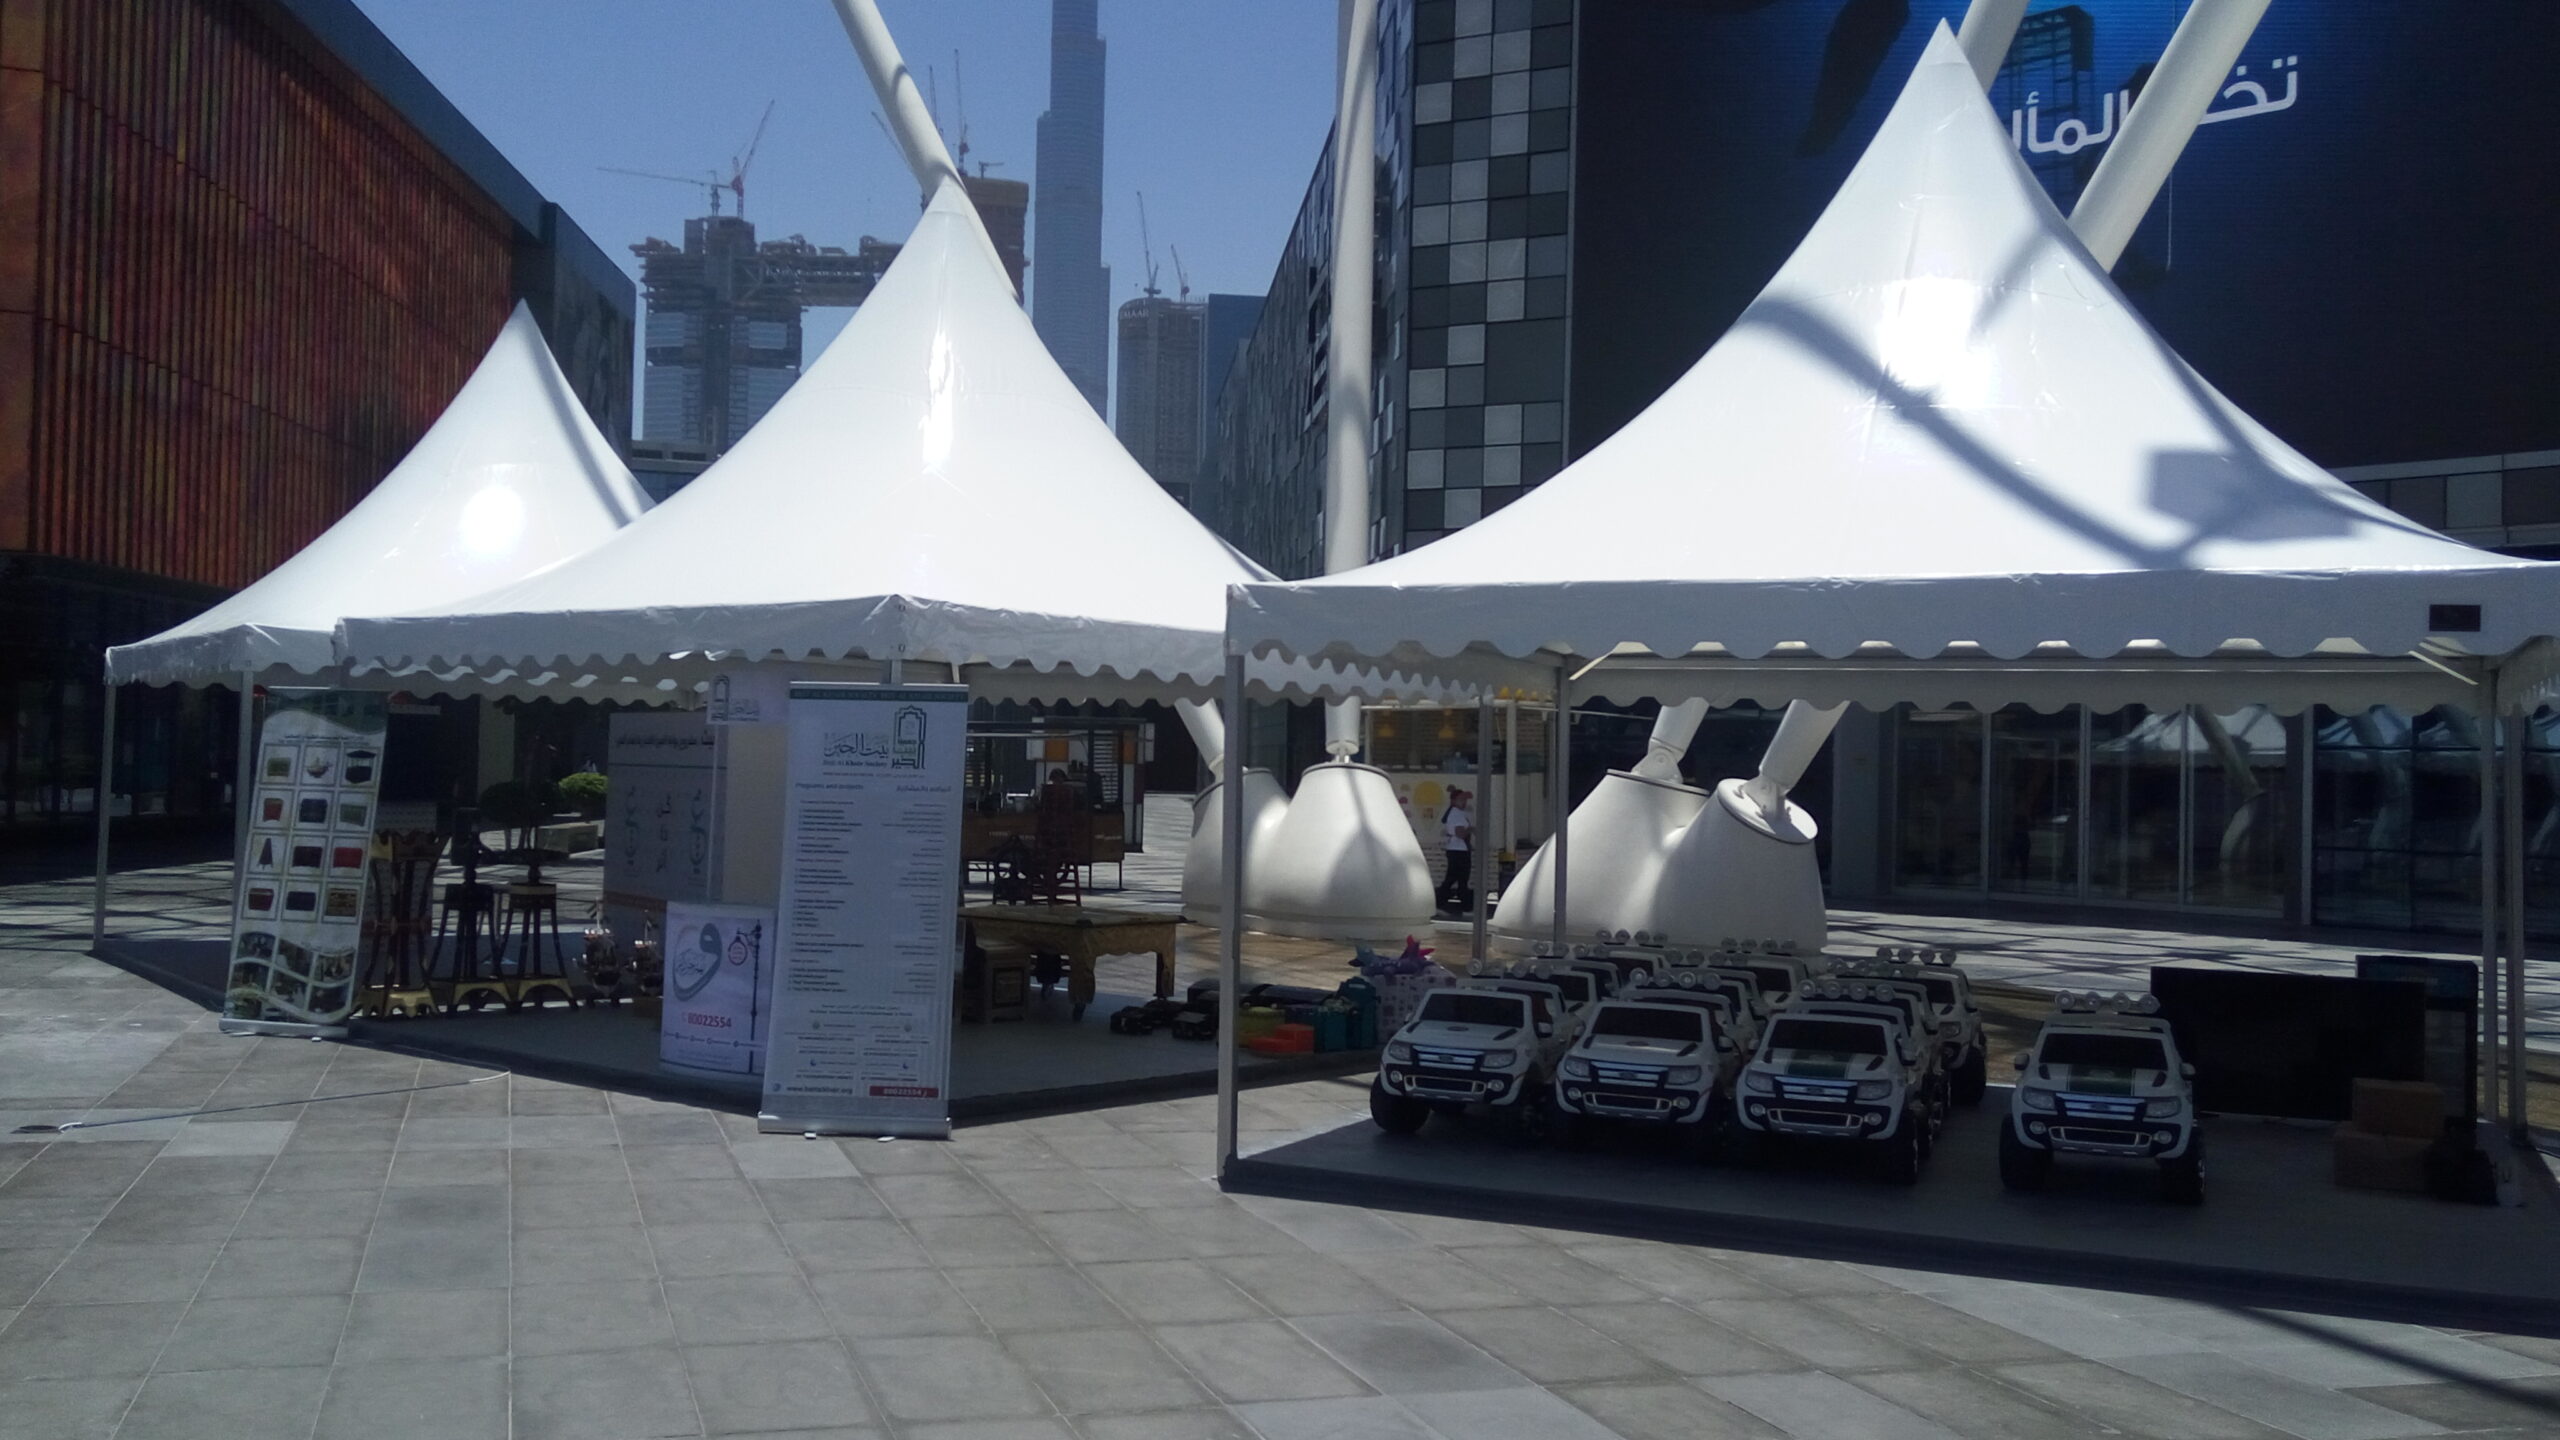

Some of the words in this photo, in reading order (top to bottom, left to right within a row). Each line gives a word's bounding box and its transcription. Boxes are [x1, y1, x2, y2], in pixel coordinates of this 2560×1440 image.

[2012, 89, 2130, 155] المأل
[2197, 55, 2298, 126] تخ
[687, 1011, 732, 1029] 80022554
